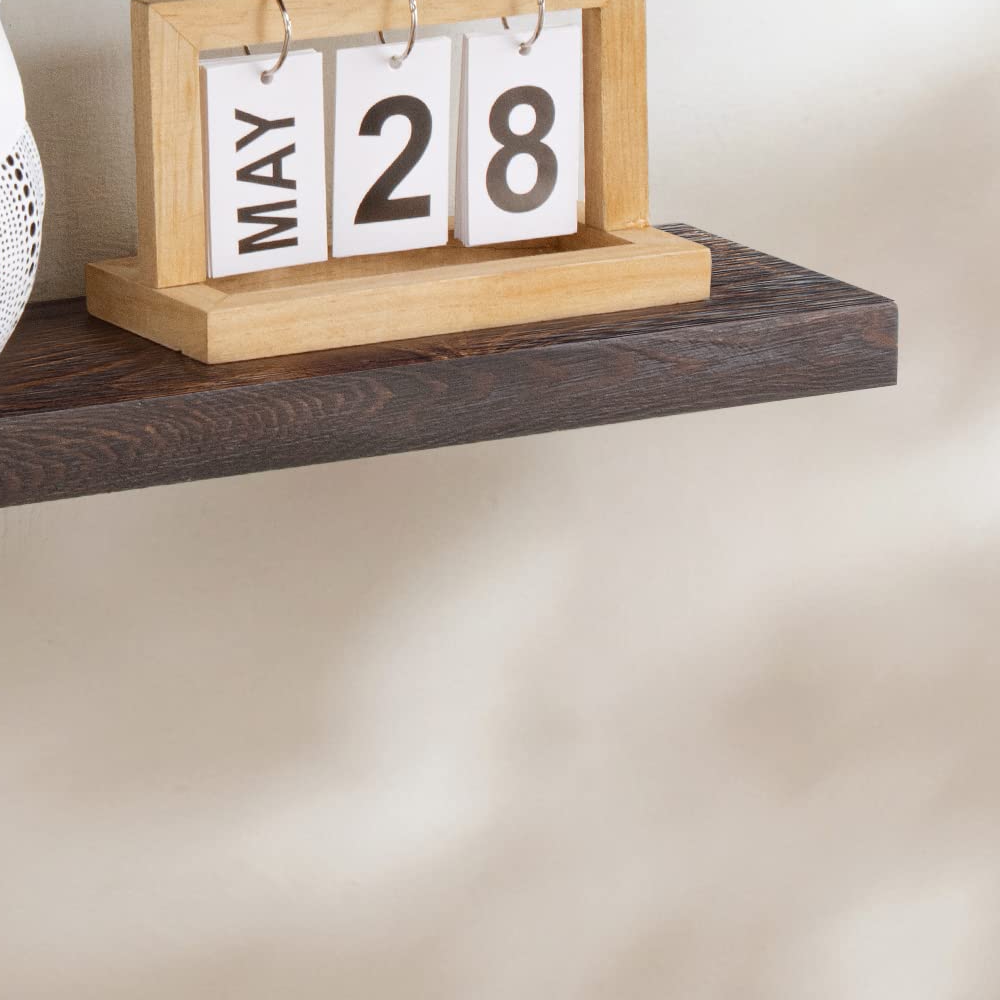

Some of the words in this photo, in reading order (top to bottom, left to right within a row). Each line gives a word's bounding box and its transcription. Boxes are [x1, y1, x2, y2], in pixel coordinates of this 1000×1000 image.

[234, 107, 299, 255] MAY
[353, 94, 433, 225] 2
[485, 84, 558, 214] 8
